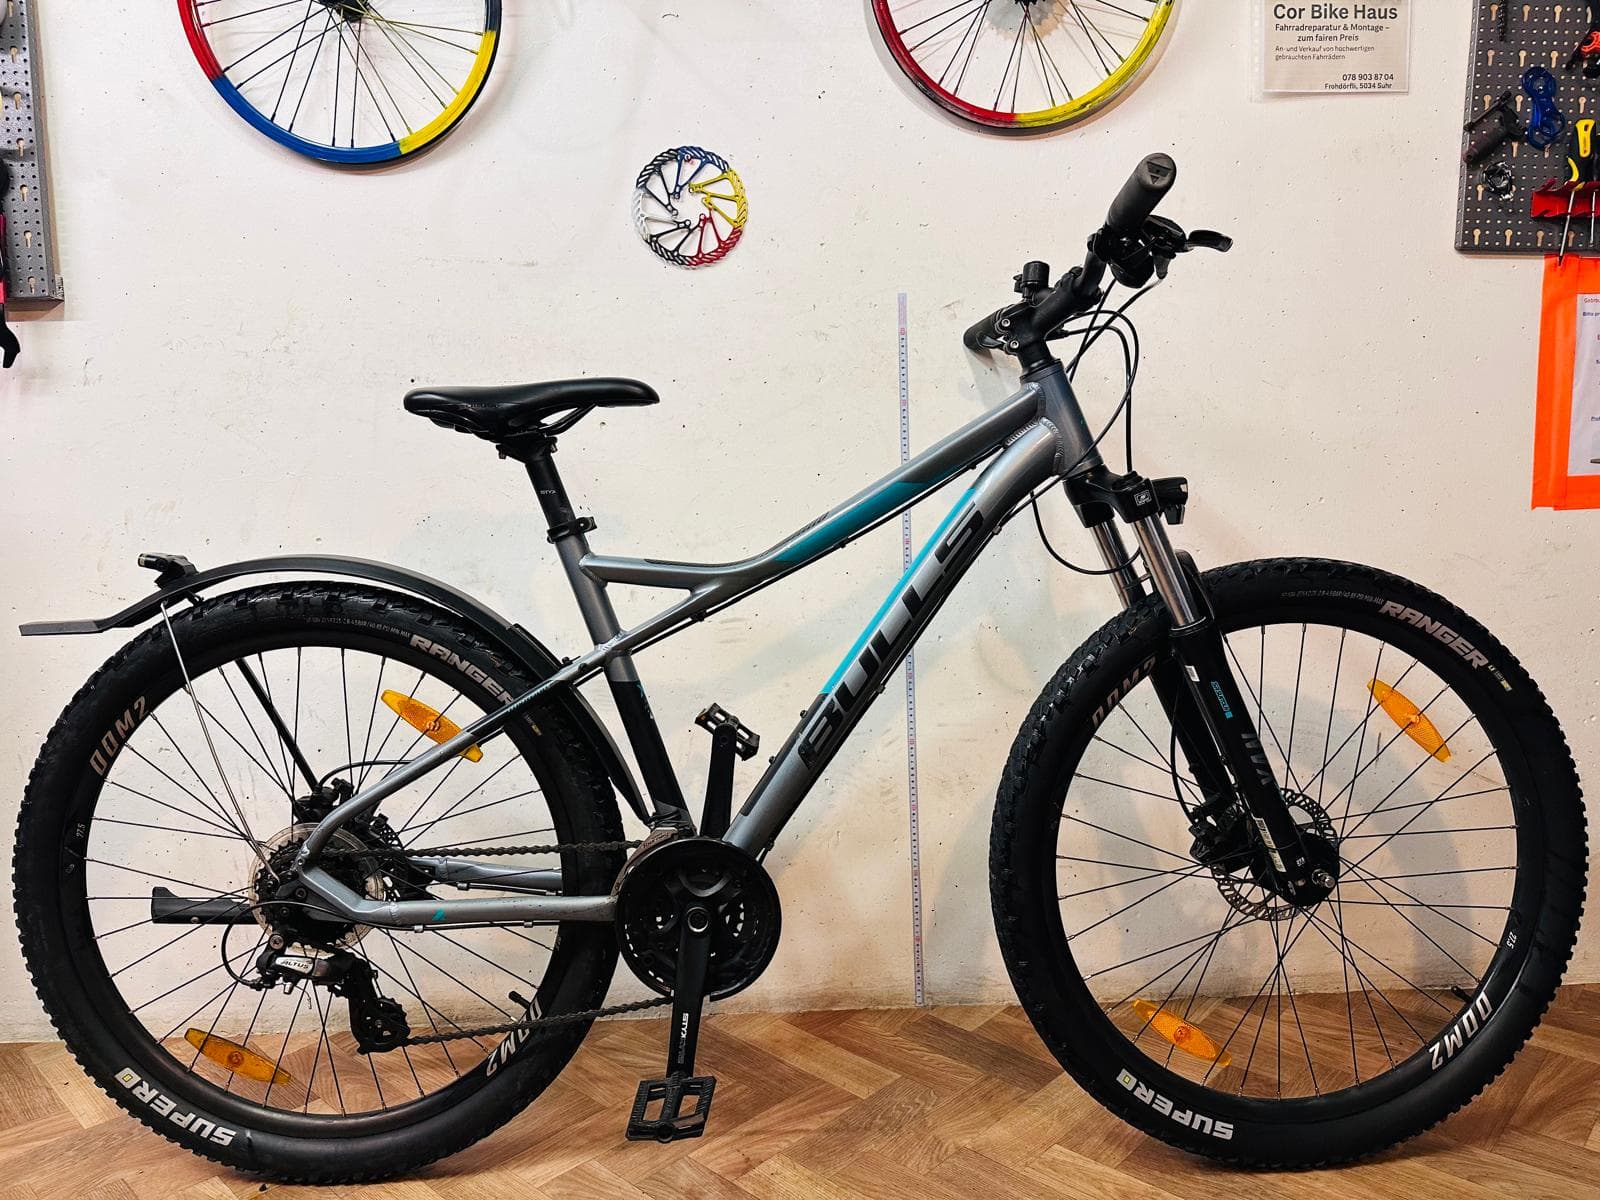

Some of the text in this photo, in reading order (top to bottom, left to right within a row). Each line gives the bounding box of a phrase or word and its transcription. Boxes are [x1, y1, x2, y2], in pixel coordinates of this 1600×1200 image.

[1273, 3, 1398, 20] Cor Bike Haus
[1275, 23, 1342, 33] Fahrradreparatur
[1342, 23, 1349, 31] &
[1350, 23, 1384, 33] Montage
[1315, 34, 1338, 42] fairen
[1339, 34, 1359, 42] Preis
[1342, 73, 1357, 81] 078
[1358, 73, 1373, 81] 903
[1359, 82, 1376, 90] 5034
[1377, 82, 1392, 90] Suhr
[798, 501, 984, 770] BULLS
[1379, 600, 1489, 669] RANGER
[280, 960, 309, 969] ALTUS
[680, 1012, 689, 1038] STYX
[114, 1067, 237, 1146] SUPERO
[1116, 1068, 1234, 1140] SUPERO
